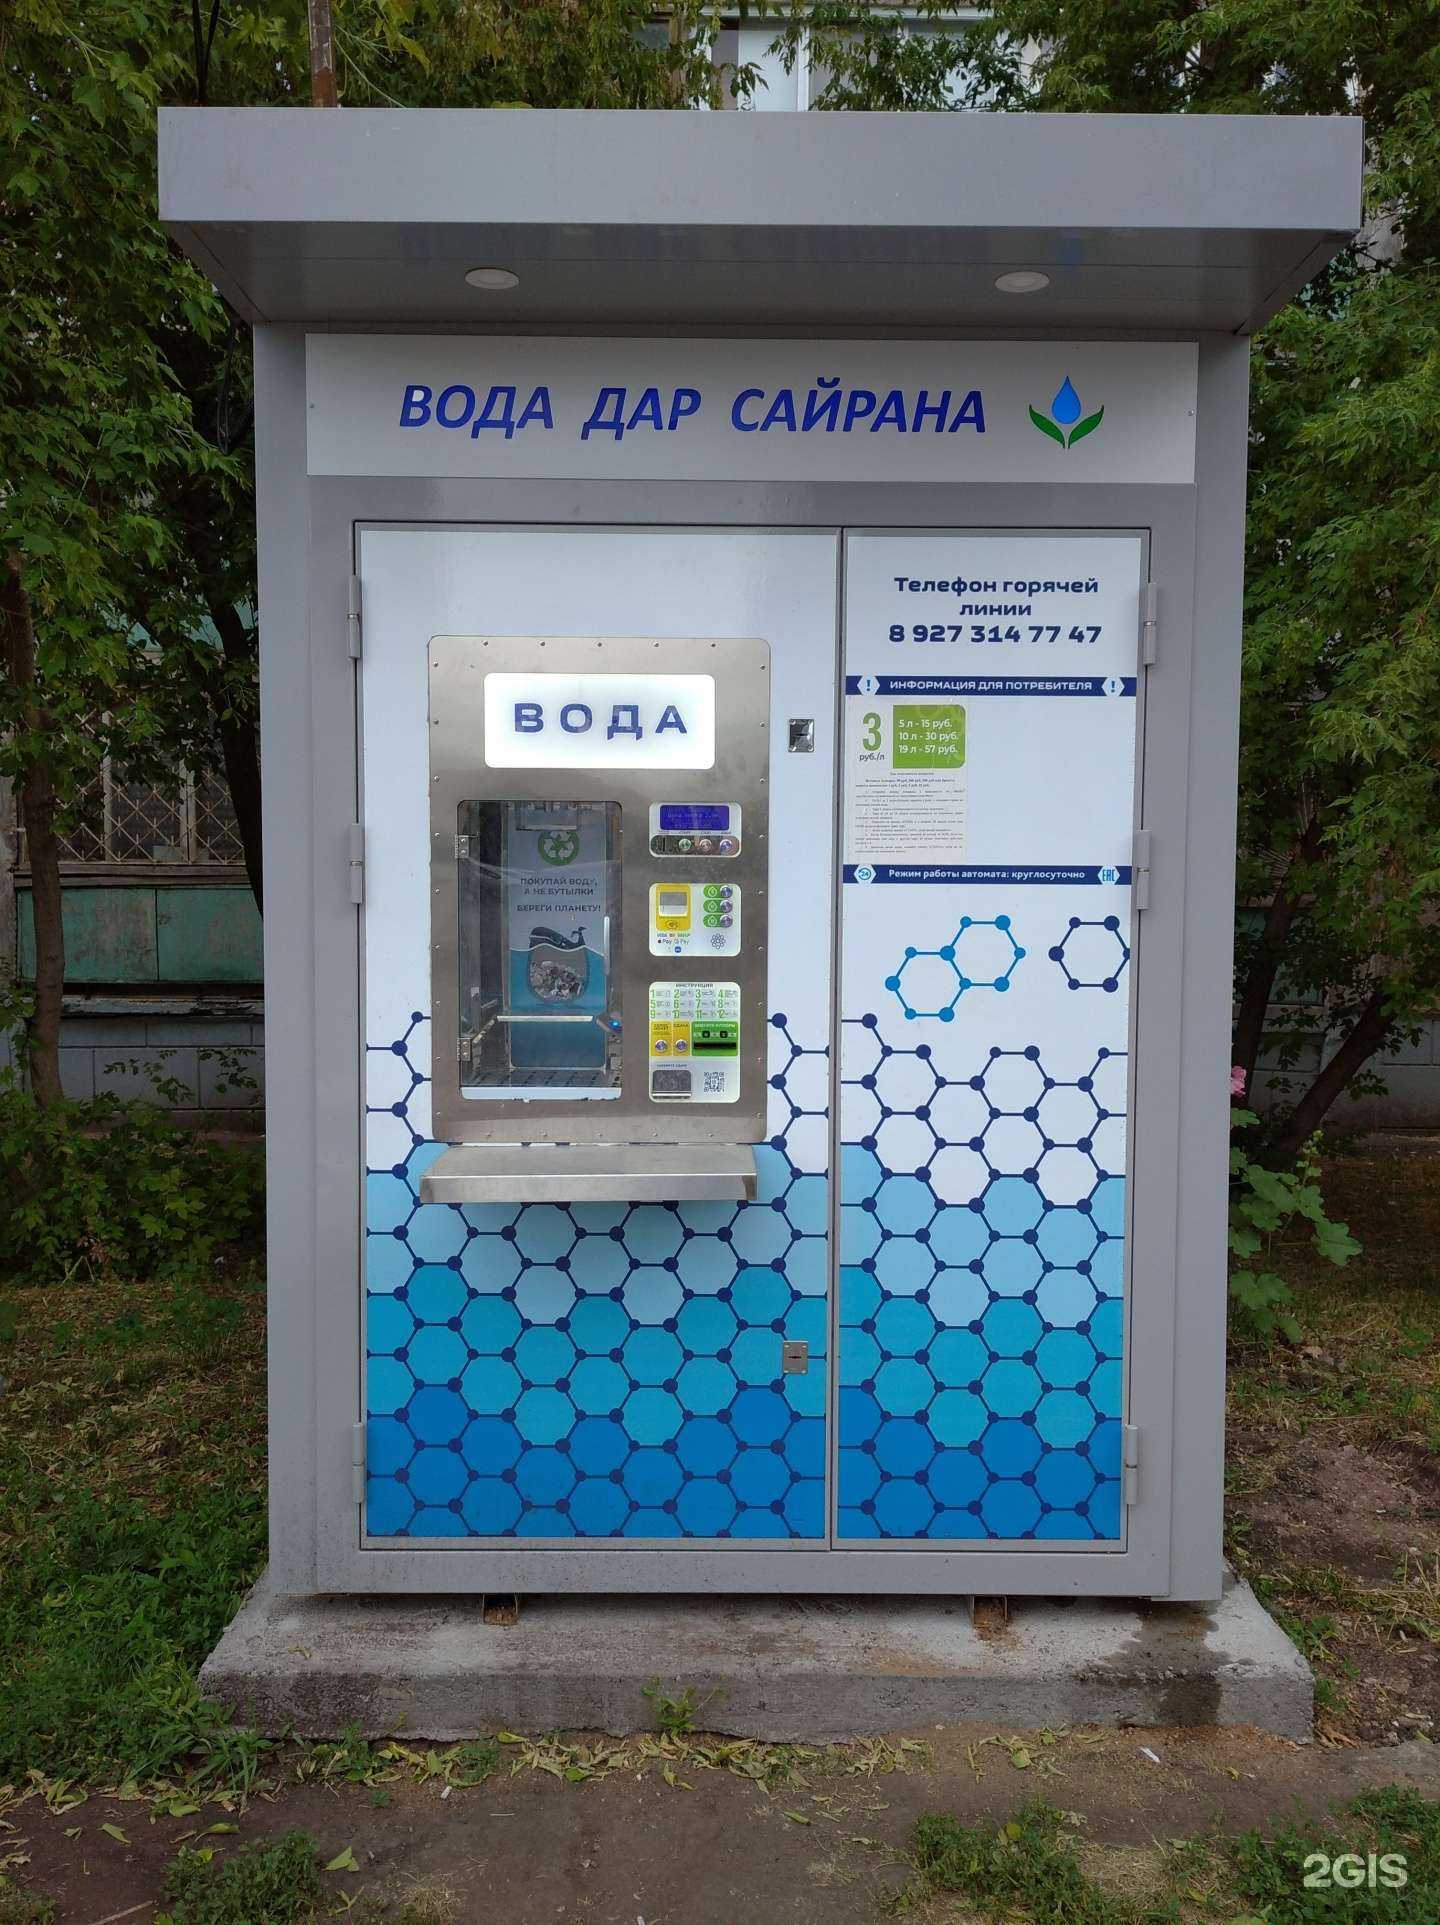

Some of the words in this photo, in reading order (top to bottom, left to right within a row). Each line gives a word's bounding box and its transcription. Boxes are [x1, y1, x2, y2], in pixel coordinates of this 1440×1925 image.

[399, 385, 554, 439] ВОДА
[581, 387, 701, 441] ДАР
[731, 376, 986, 433] САЙРАНА
[894, 576, 996, 596] Телефон
[1004, 578, 1098, 597] горячей
[960, 604, 1032, 616] линии
[889, 624, 905, 642] 8
[912, 624, 963, 642] 927
[970, 625, 1021, 643] 314
[1028, 626, 1062, 643] 77
[1068, 626, 1102, 643] 47
[890, 680, 976, 691] ИНФОРМАЦИЯ
[978, 680, 1004, 692] ДЛЯ
[1006, 681, 1092, 691] ПОТРЕБИТЕЛЯ
[514, 702, 688, 741] ВОДА
[899, 720, 905, 728] 5
[921, 720, 930, 728] 15
[932, 718, 952, 730] руб.
[862, 712, 881, 751] 3
[899, 732, 908, 740] 10
[925, 732, 936, 740] 30
[939, 732, 959, 742] руб.
[898, 745, 908, 753] 19
[938, 744, 958, 755] руб.
[859, 752, 885, 762] руб./л
[888, 870, 921, 878] Режим
[923, 869, 959, 879] работы
[1012, 871, 1085, 880] круглосуточно
[520, 877, 567, 886] ПОКУПАЙ
